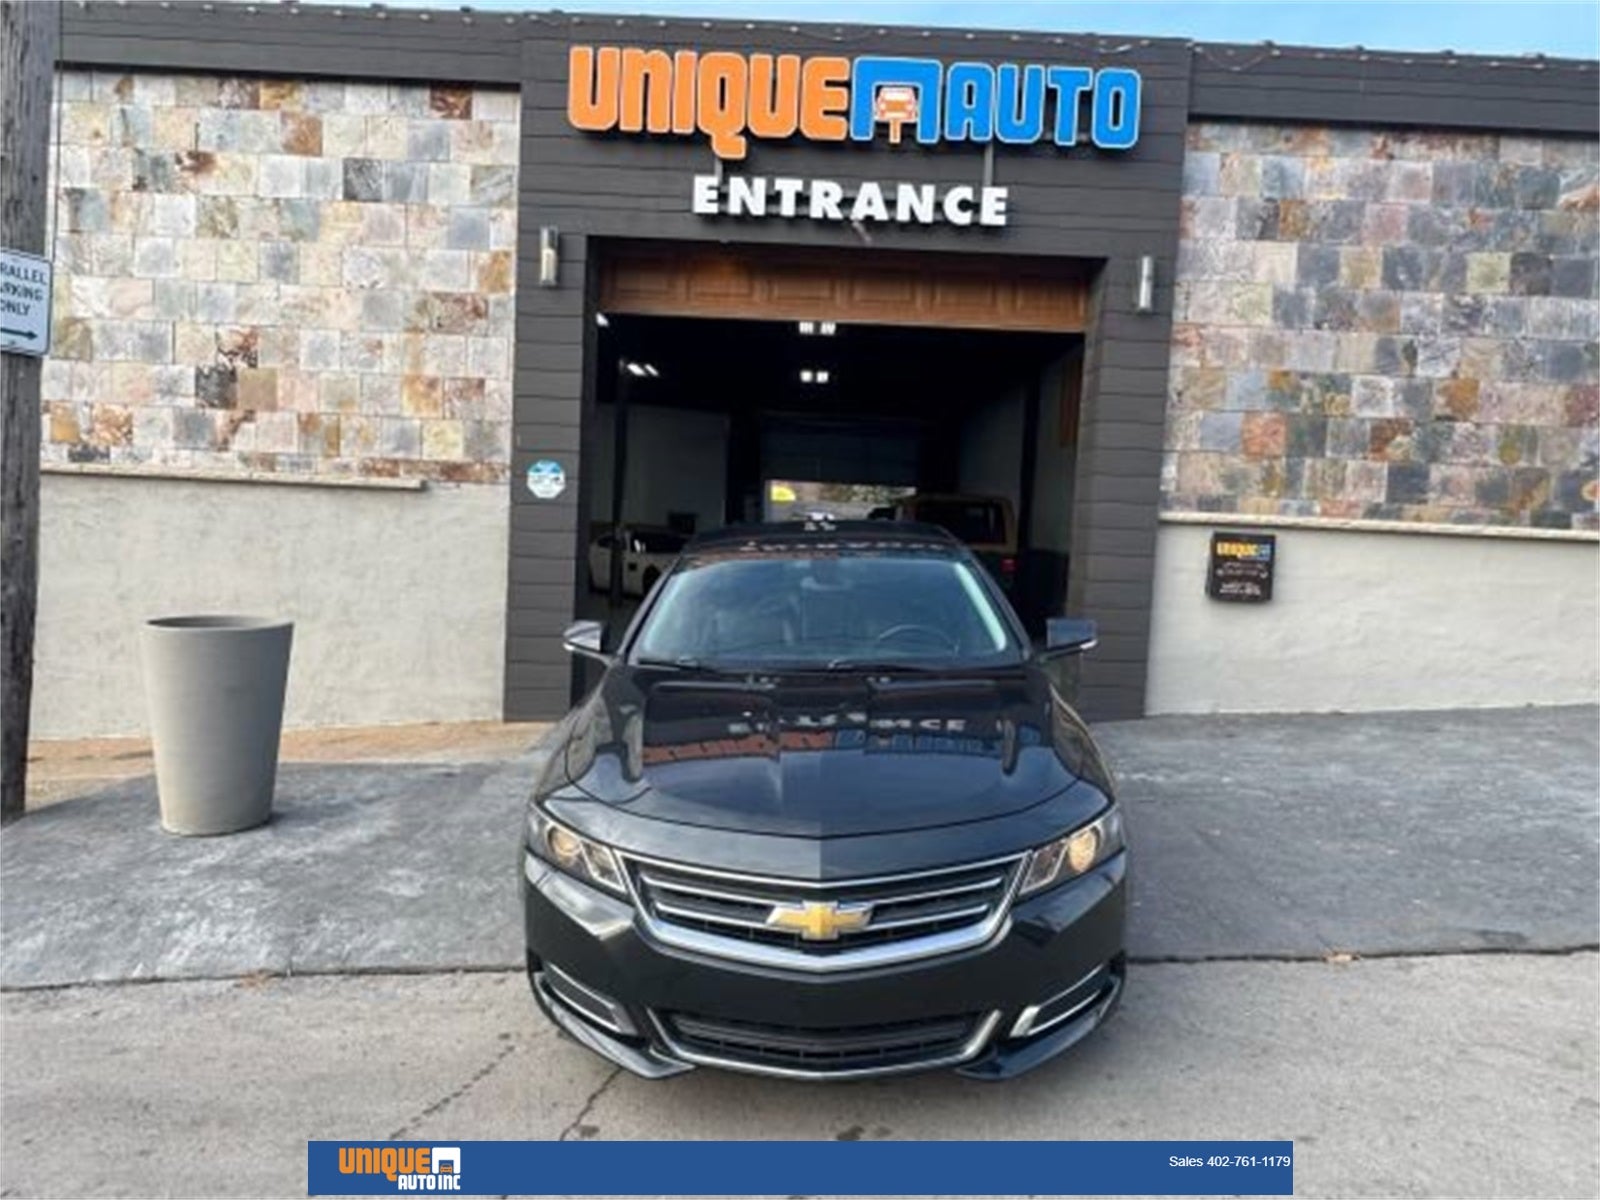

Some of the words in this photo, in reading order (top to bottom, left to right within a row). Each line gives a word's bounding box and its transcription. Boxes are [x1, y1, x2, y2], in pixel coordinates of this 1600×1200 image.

[567, 45, 850, 159] UNIQUE
[943, 61, 1141, 150] AUTO
[692, 174, 1009, 226] ENTRANCE
